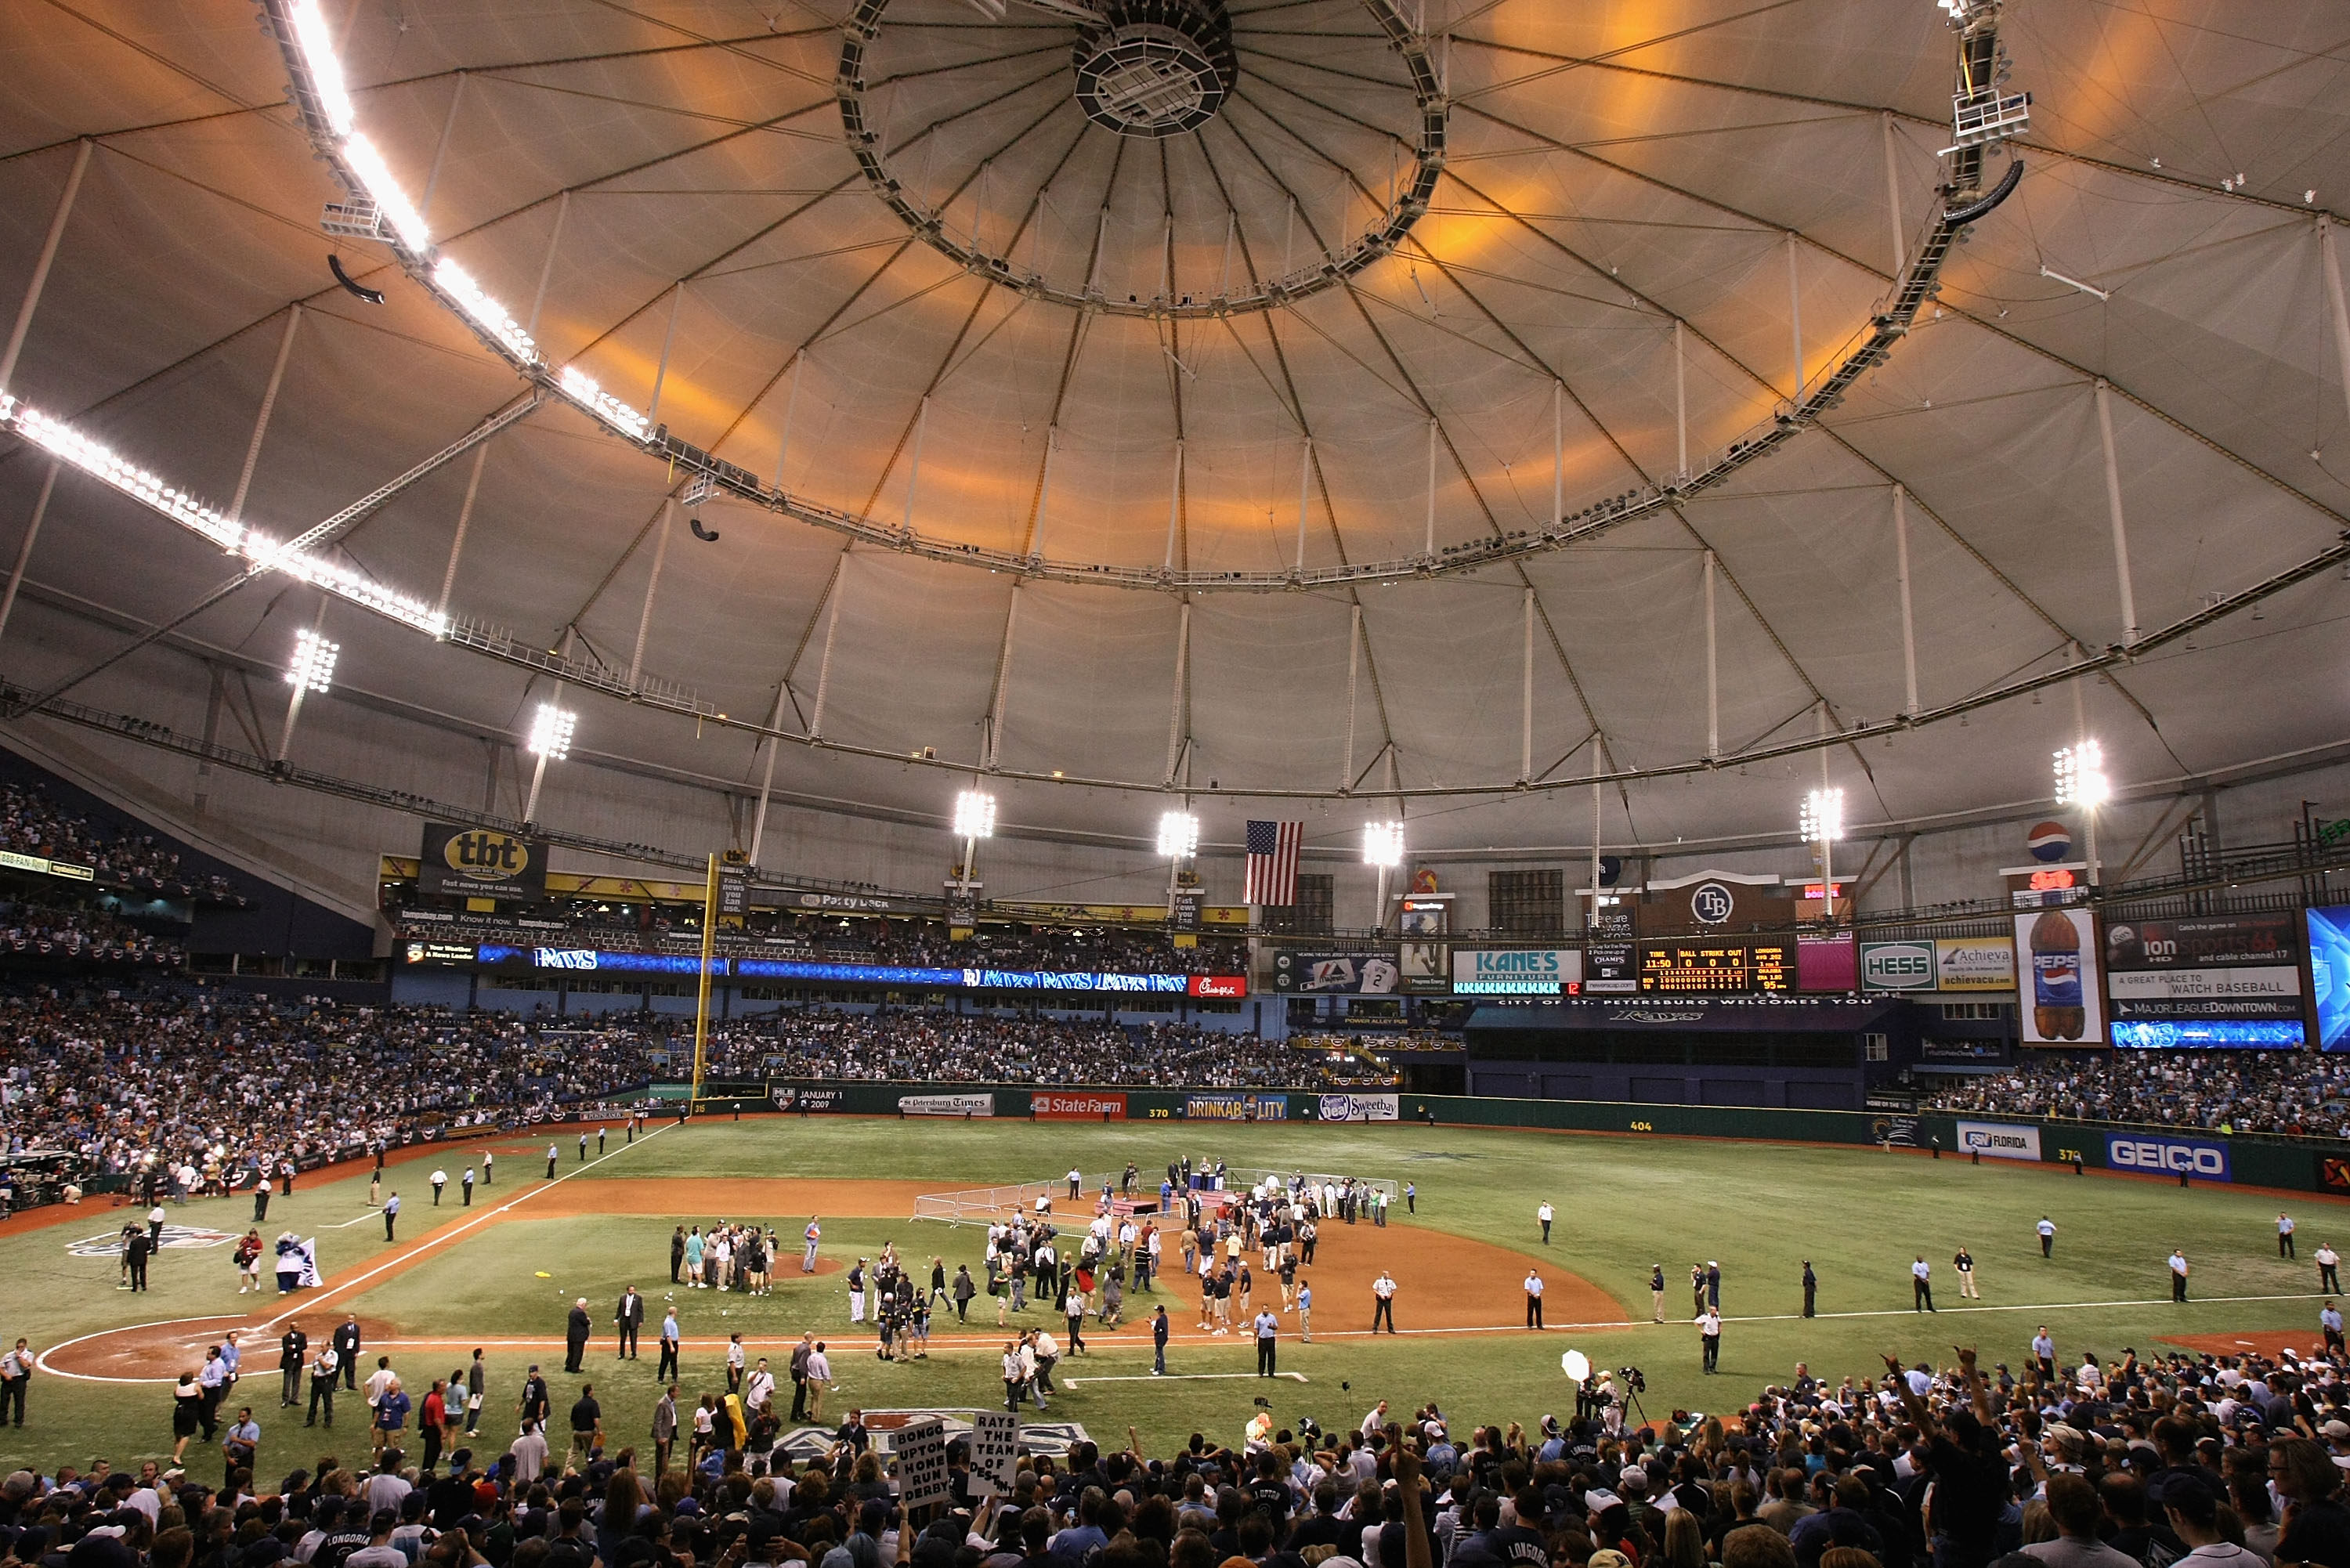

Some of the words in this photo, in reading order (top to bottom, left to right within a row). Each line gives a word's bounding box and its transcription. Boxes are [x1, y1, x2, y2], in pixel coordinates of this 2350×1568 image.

[457, 833, 518, 869] tbt
[822, 895, 857, 908] Party
[1699, 891, 1726, 916] TB
[402, 910, 453, 921] tampabay.com
[461, 914, 484, 923] Know
[519, 919, 565, 929] tampabay.com
[2144, 939, 2177, 956] ion
[407, 950, 424, 962] 9
[1959, 948, 2009, 962] Achieva
[2199, 954, 2214, 963] and
[2216, 953, 2238, 962] cable
[2240, 951, 2275, 960] channel
[2276, 950, 2288, 959] 17
[1477, 952, 1559, 972] KANE'S
[1646, 959, 1671, 968] 11:50
[1686, 959, 1692, 967] 0
[1709, 959, 1716, 967] 0
[1732, 958, 1739, 966] 0
[1868, 956, 1928, 975] HESS
[1035, 970, 1091, 990] RAYS
[1373, 974, 1382, 987] 2
[1763, 981, 1777, 989] 95
[1944, 975, 2010, 985] achievacu.com
[1568, 983, 1579, 995] 12
[2171, 984, 2211, 994] WATCH
[2217, 982, 2284, 993] BASEBALL
[800, 1091, 836, 1100] JANUARY
[838, 1091, 843, 1100] 1
[1324, 1097, 1343, 1106] Sweet
[913, 1099, 951, 1107] Petersburg
[953, 1098, 985, 1107] Times
[1188, 1100, 1285, 1118] DRINKABLITY
[1351, 1100, 1396, 1116] Sweetbay
[1149, 1109, 1168, 1118] 370
[1324, 1104, 1349, 1117] Deal
[1630, 1121, 1652, 1131] 404
[1969, 1133, 1990, 1146] FSN
[1994, 1136, 2027, 1149] FLORIDA
[2110, 1140, 2224, 1175] GEICO
[978, 1416, 1015, 1428] RAYS
[898, 1425, 944, 1445] BONGO
[984, 1430, 1013, 1442] THE
[899, 1440, 945, 1461] UPTON
[977, 1443, 1014, 1455] TEAM
[1570, 1444, 1596, 1456] LONGORIA
[905, 1455, 945, 1475] HOME
[985, 1458, 1004, 1469] OF
[913, 1469, 941, 1486] RUN
[970, 1461, 1014, 1497] DESTINY
[905, 1480, 949, 1501] DERBY
[1260, 1489, 1281, 1501] UPTON
[327, 1534, 371, 1547] LONGORIA
